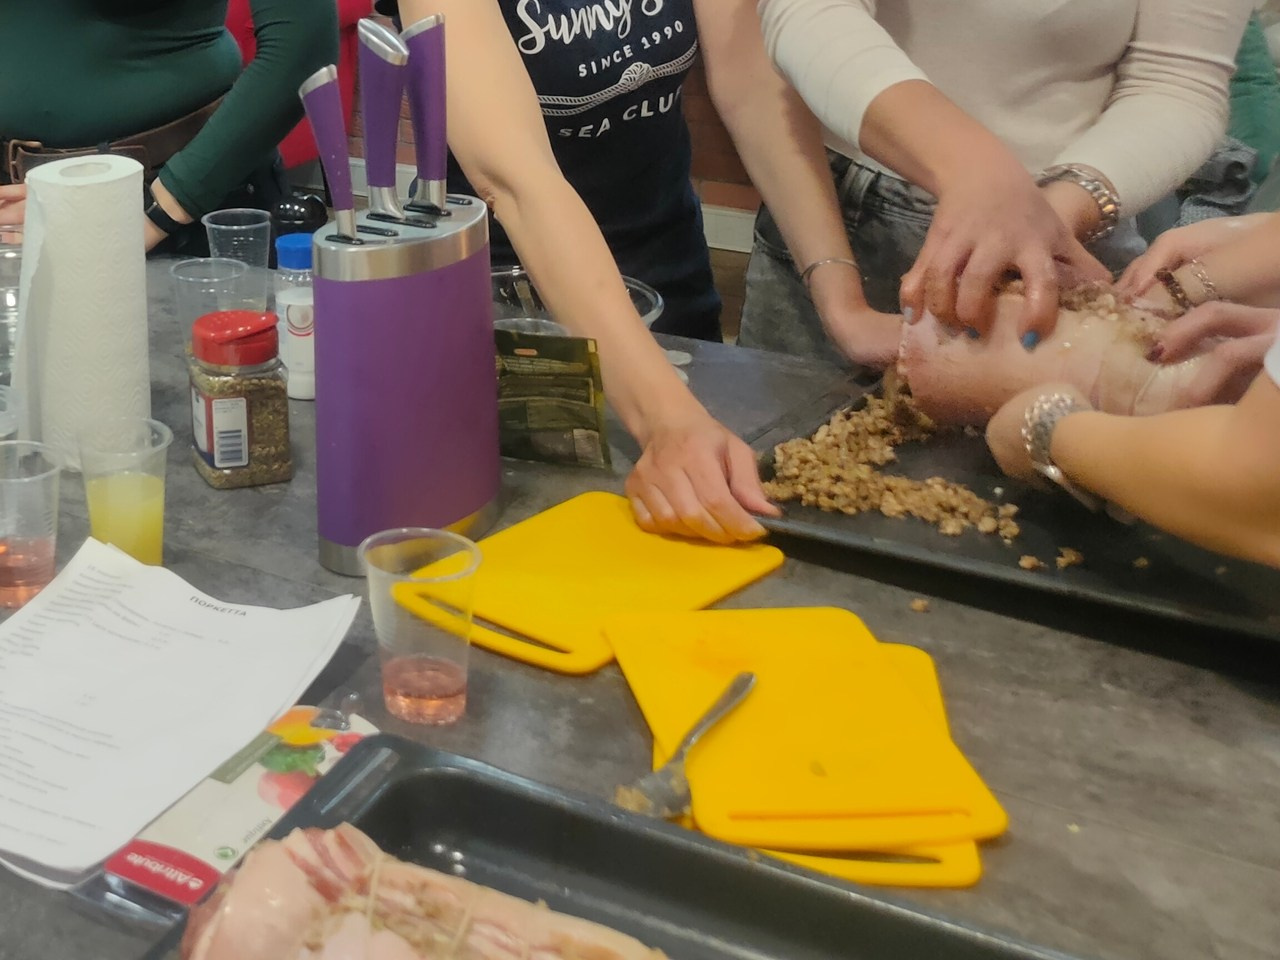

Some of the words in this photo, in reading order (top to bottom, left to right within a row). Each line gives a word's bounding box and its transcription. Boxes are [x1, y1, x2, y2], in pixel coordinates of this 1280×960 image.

[578, 45, 633, 77] SINCE
[641, 20, 683, 50] 1990
[558, 118, 610, 139] SEA
[190, 596, 247, 617] ПОРКЕТТА
